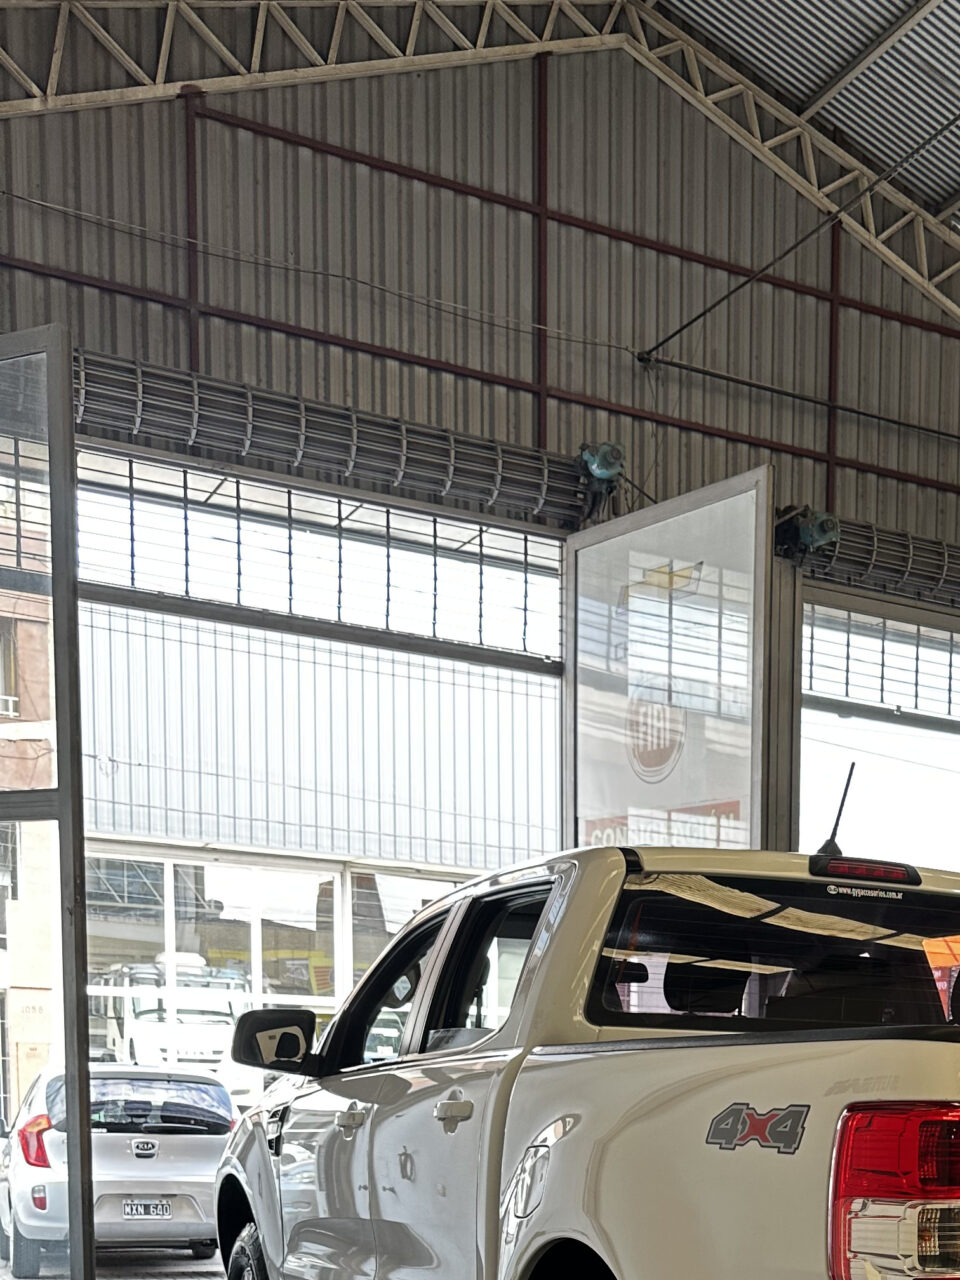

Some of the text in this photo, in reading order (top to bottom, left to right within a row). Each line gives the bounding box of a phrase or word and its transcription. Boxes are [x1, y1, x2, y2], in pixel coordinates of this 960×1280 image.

[137, 1142, 154, 1150] KIA
[124, 1204, 170, 1215] MXN 640
